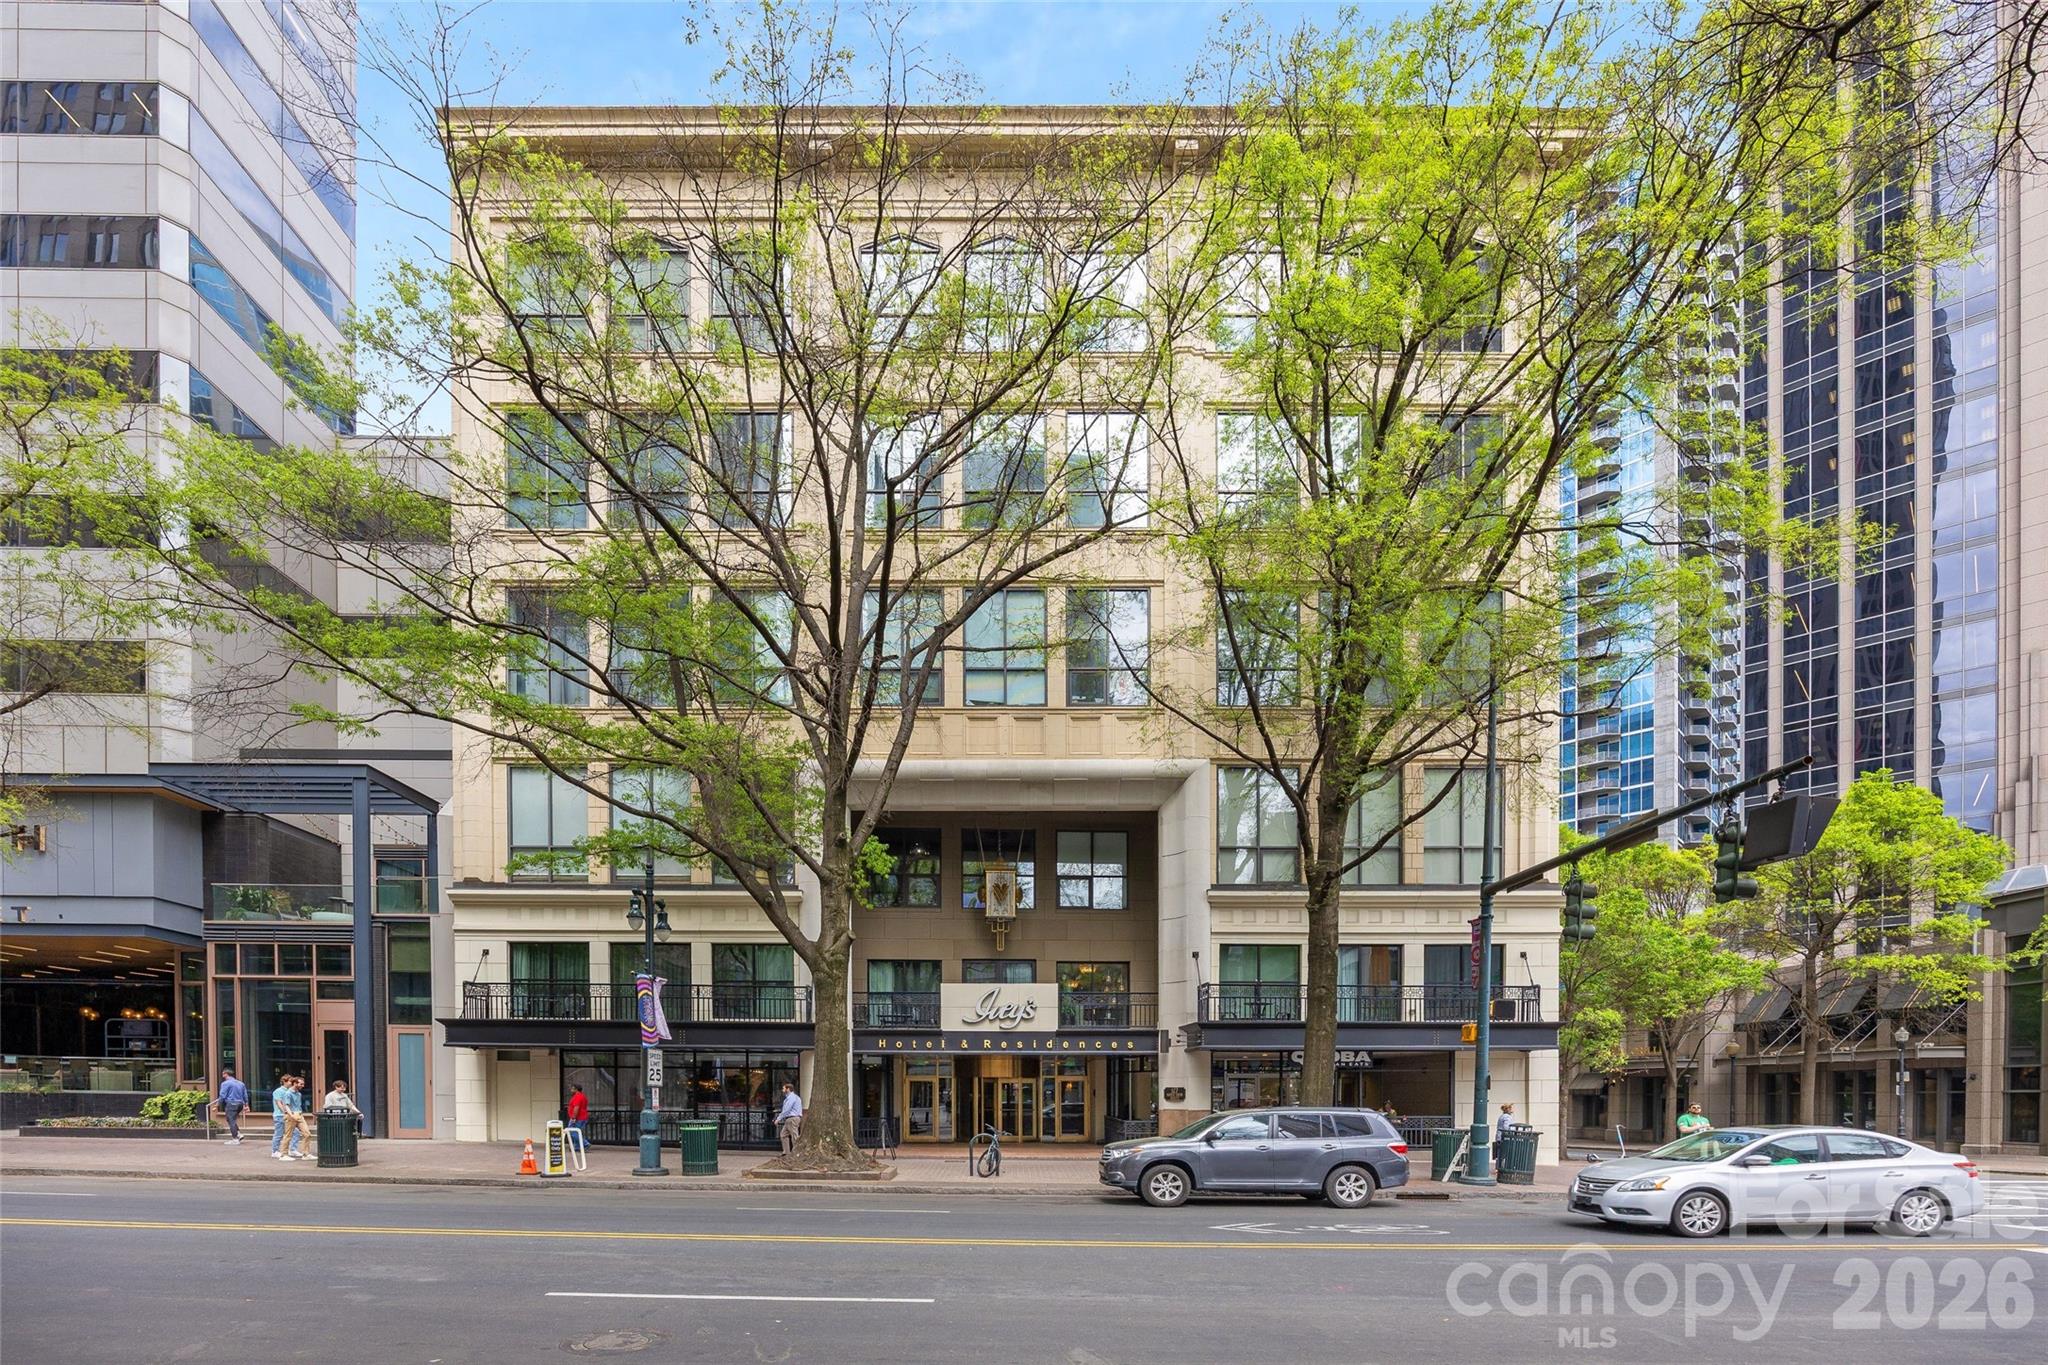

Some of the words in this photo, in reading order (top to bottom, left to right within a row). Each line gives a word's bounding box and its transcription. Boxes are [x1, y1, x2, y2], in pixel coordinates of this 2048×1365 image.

[962, 987, 1037, 1030] Ivey's
[879, 1039, 945, 1049] Hotel
[961, 1040, 968, 1048] &
[984, 1039, 1134, 1049] Residences
[1291, 1050, 1371, 1065] QBA
[649, 1068, 662, 1082] 25
